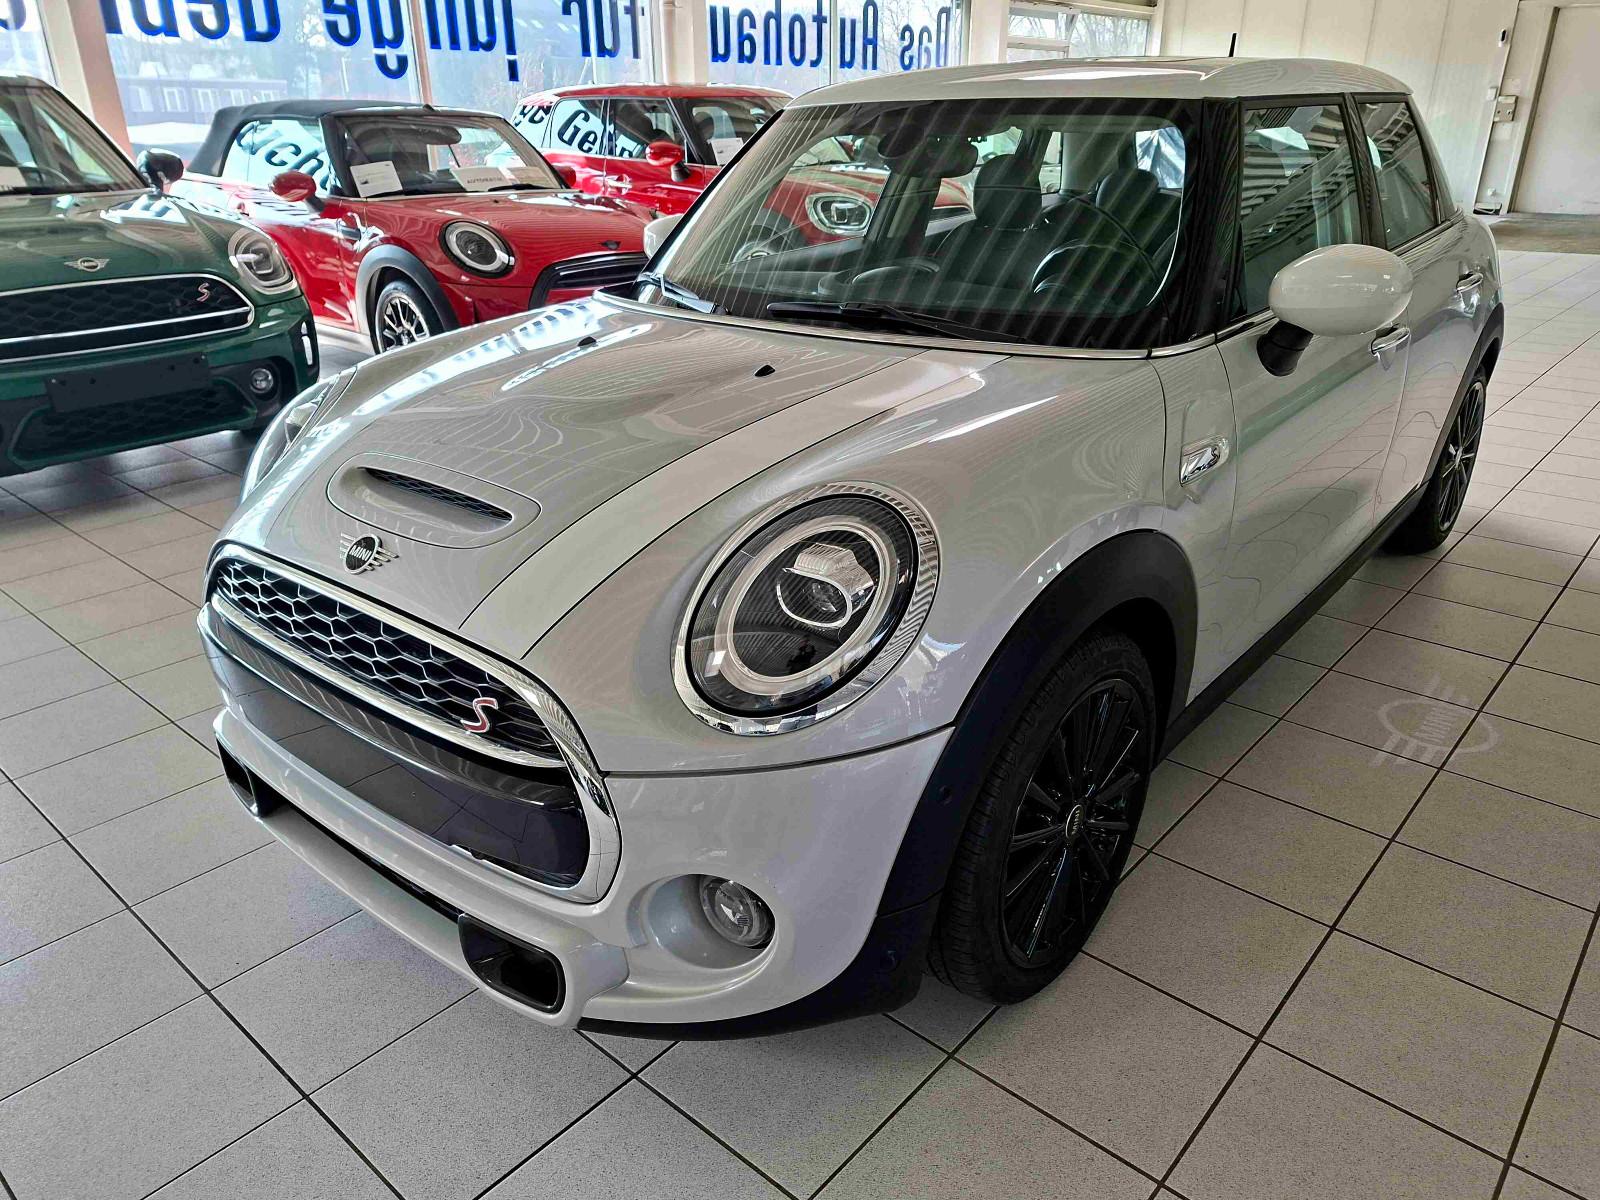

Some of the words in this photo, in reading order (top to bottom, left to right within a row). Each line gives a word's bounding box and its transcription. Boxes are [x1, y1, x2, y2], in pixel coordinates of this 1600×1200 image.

[196, 282, 210, 302] S
[348, 544, 373, 562] MINI
[460, 697, 499, 733] S
